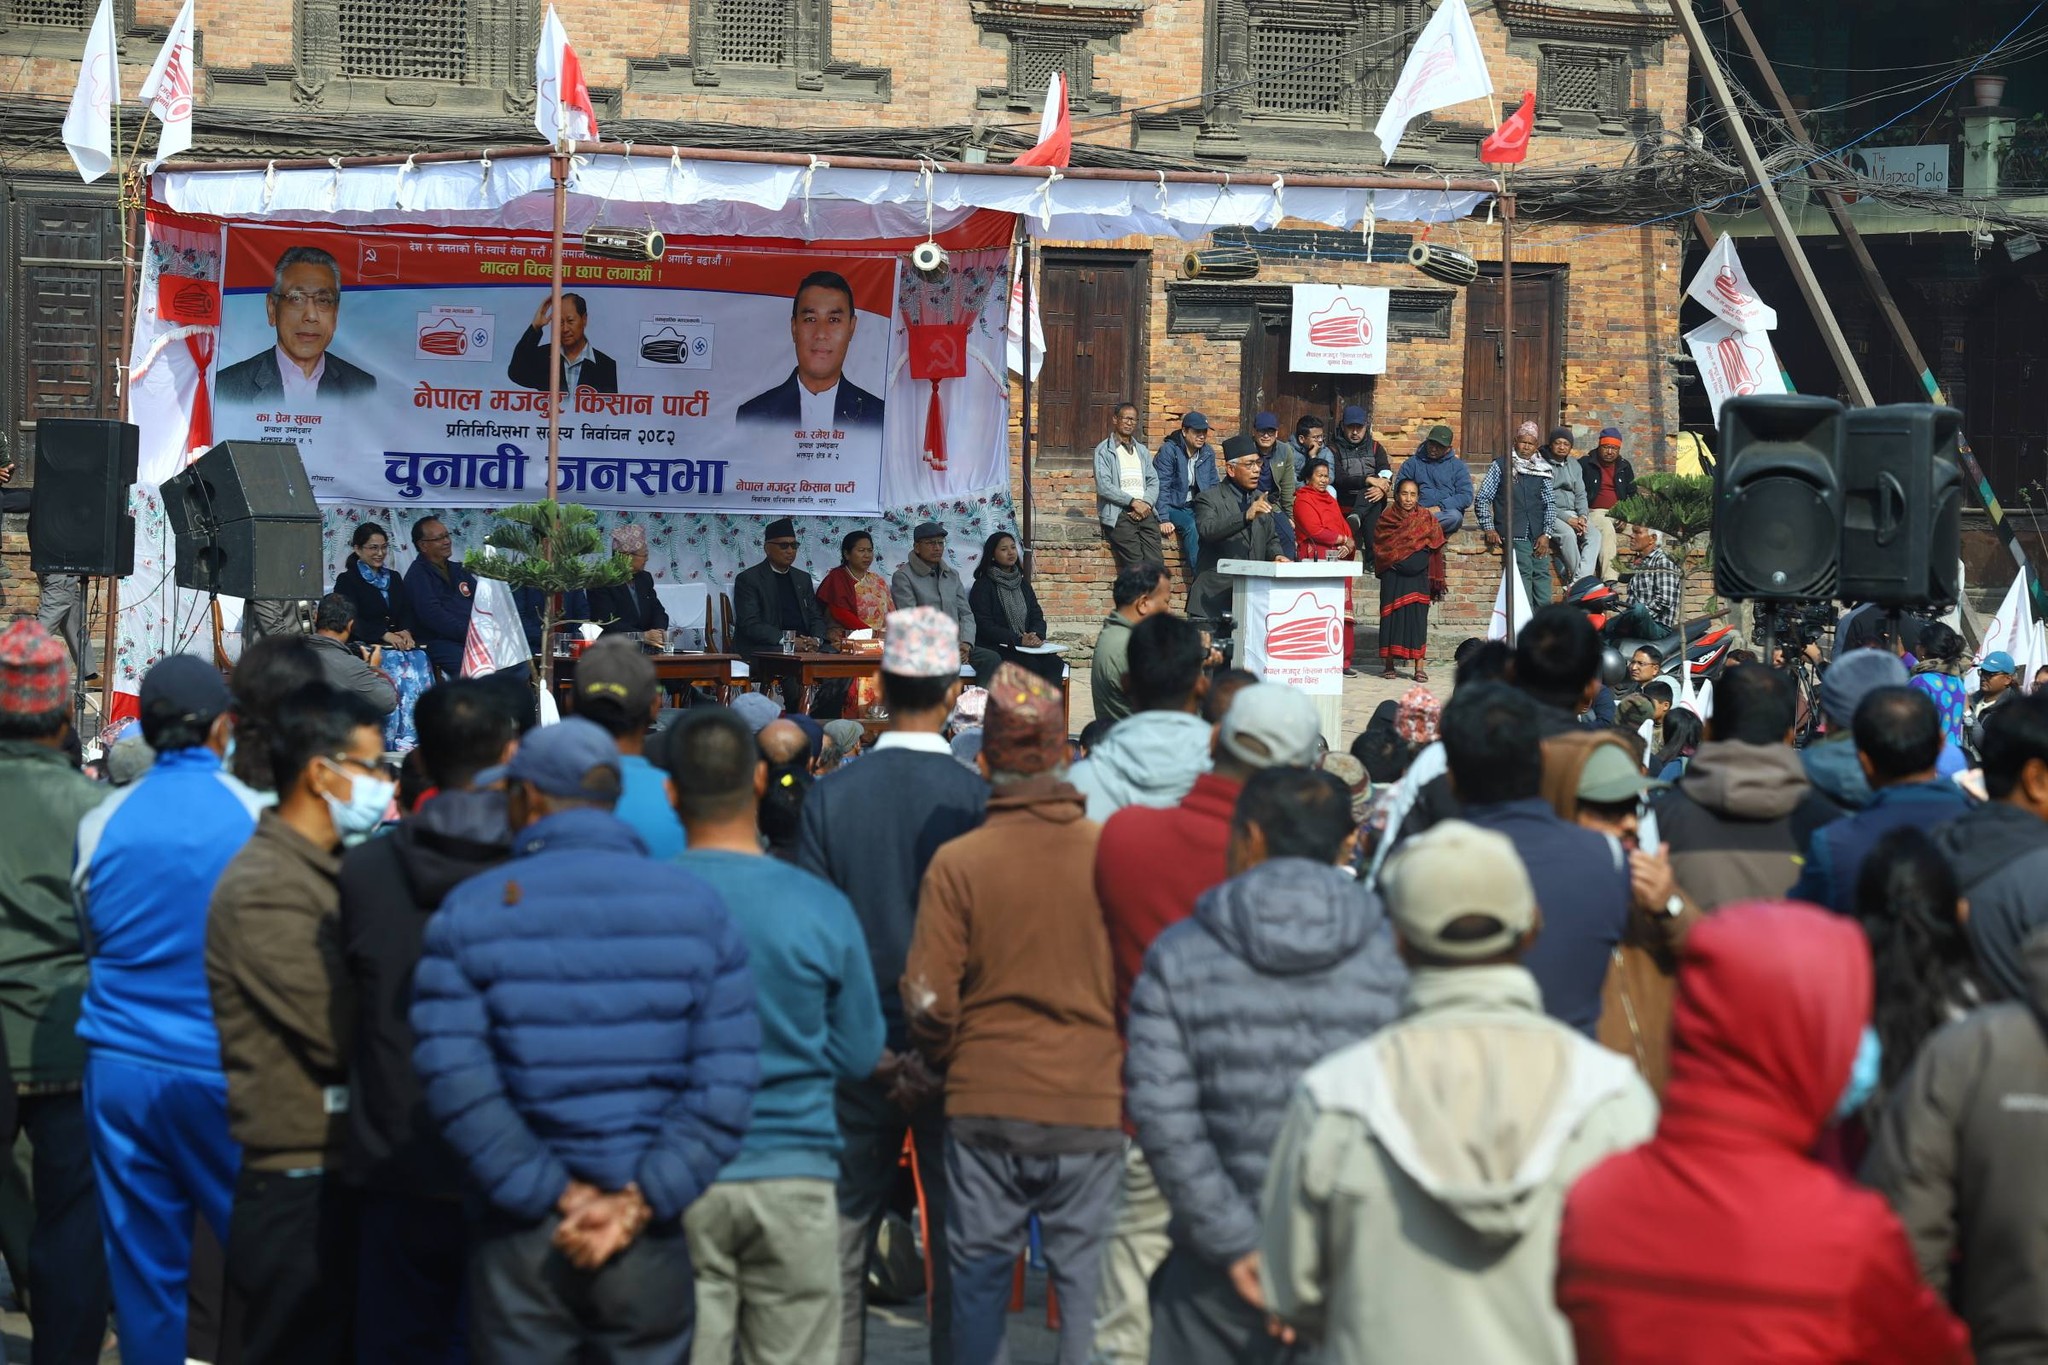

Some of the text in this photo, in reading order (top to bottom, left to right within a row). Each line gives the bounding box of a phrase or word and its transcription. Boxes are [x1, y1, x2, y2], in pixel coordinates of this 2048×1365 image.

[409, 241, 423, 252] देश
[427, 243, 433, 253] र
[437, 242, 470, 253] जनताको
[480, 261, 520, 276] मादल
[575, 265, 603, 278] छाप
[413, 381, 482, 411] नेपाल
[574, 385, 655, 417] किसान
[662, 390, 709, 417] पार्टी
[446, 420, 675, 446] प्रतिनिधिसभा सस्य निर्वाचन २०८२
[383, 443, 729, 499] चुनावी जनसभा
[736, 479, 856, 495] नेपाल मजदुर किसान पार्टी
